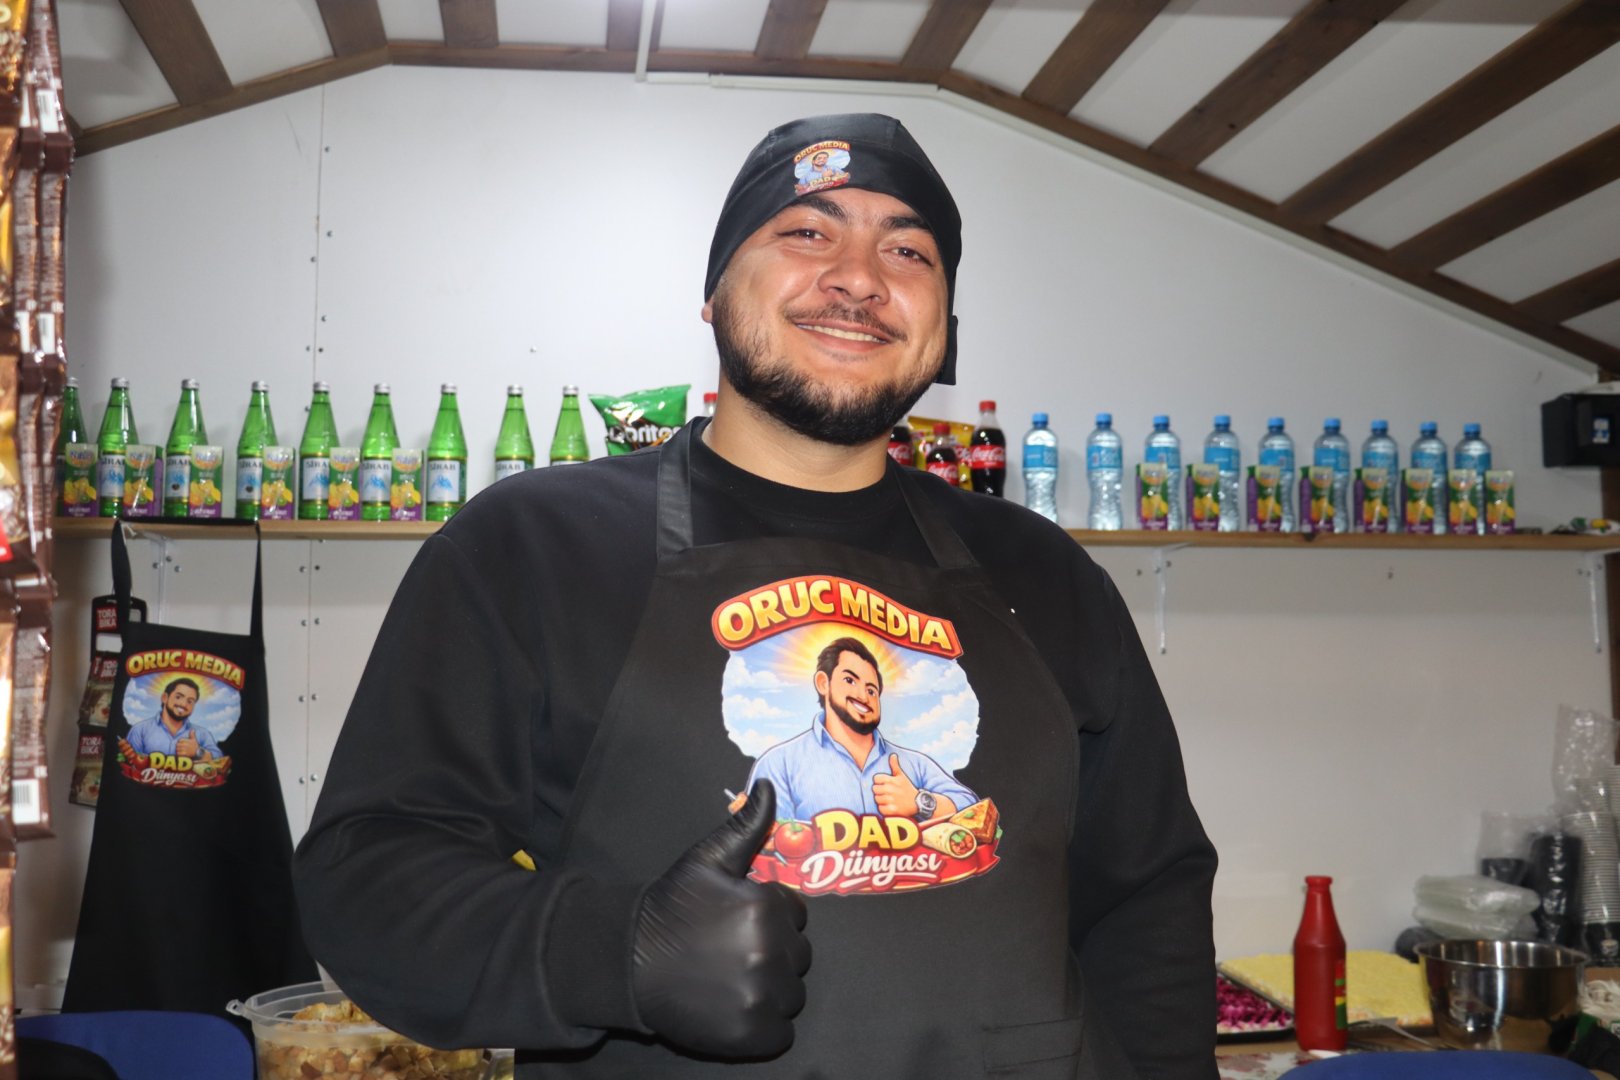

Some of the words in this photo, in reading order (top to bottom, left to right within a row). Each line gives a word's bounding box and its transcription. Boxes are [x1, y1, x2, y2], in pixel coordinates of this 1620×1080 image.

[718, 579, 834, 642] ORUC
[839, 582, 953, 650] MEDIA
[128, 651, 182, 674] ORUC
[185, 652, 243, 686] MEDIA
[141, 768, 198, 785] Dünyası
[150, 752, 193, 771] DAD
[817, 811, 919, 851] DAD
[801, 850, 942, 889] Dünyası
